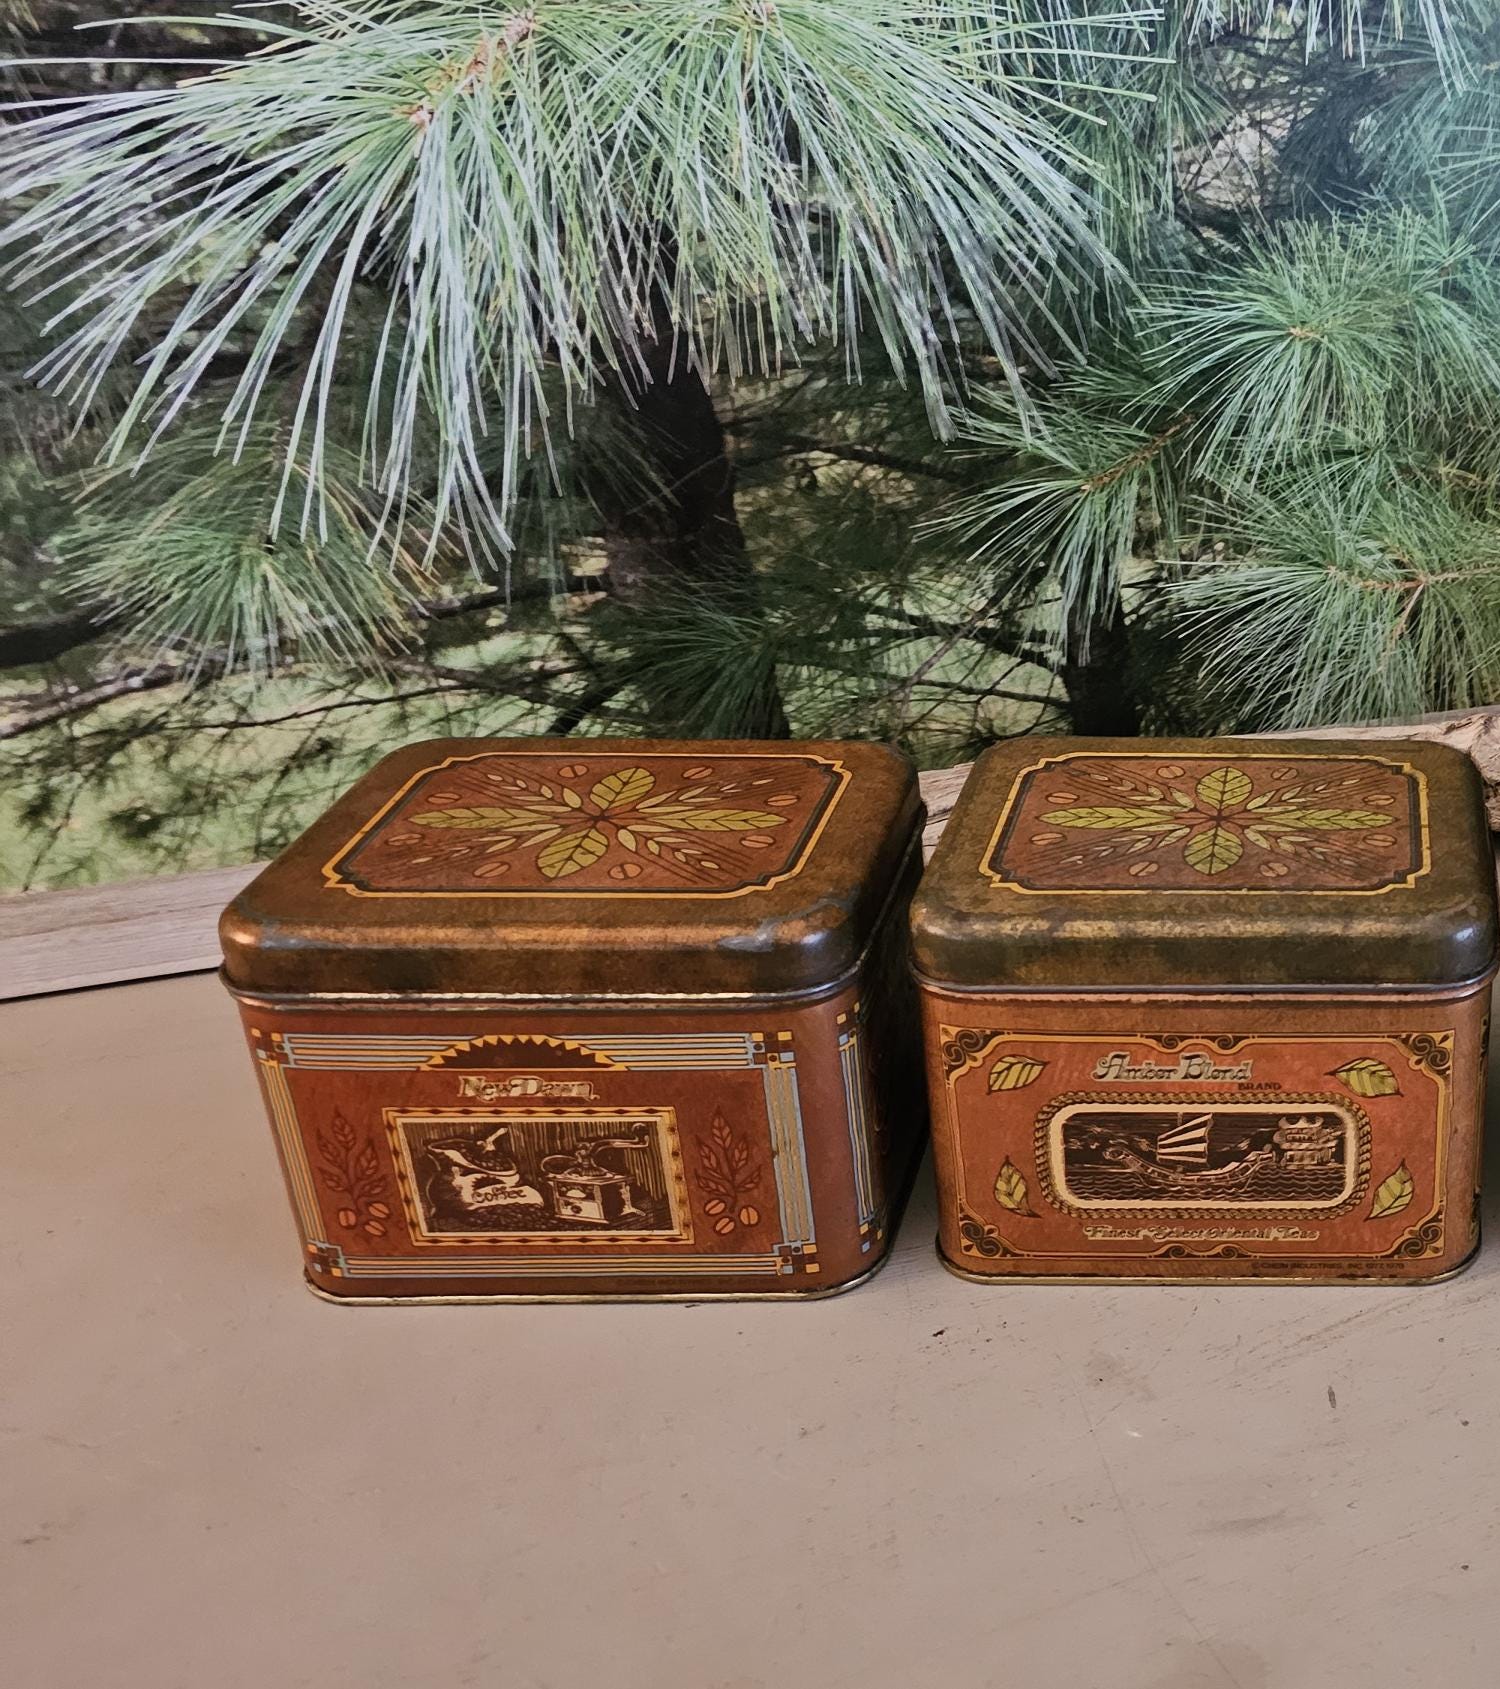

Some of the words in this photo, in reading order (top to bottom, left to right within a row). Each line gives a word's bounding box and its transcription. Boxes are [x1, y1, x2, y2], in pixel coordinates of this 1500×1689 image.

[1092, 1053, 1179, 1080] Amber
[1180, 1053, 1252, 1080] Blend
[1238, 1082, 1282, 1091] BRAND
